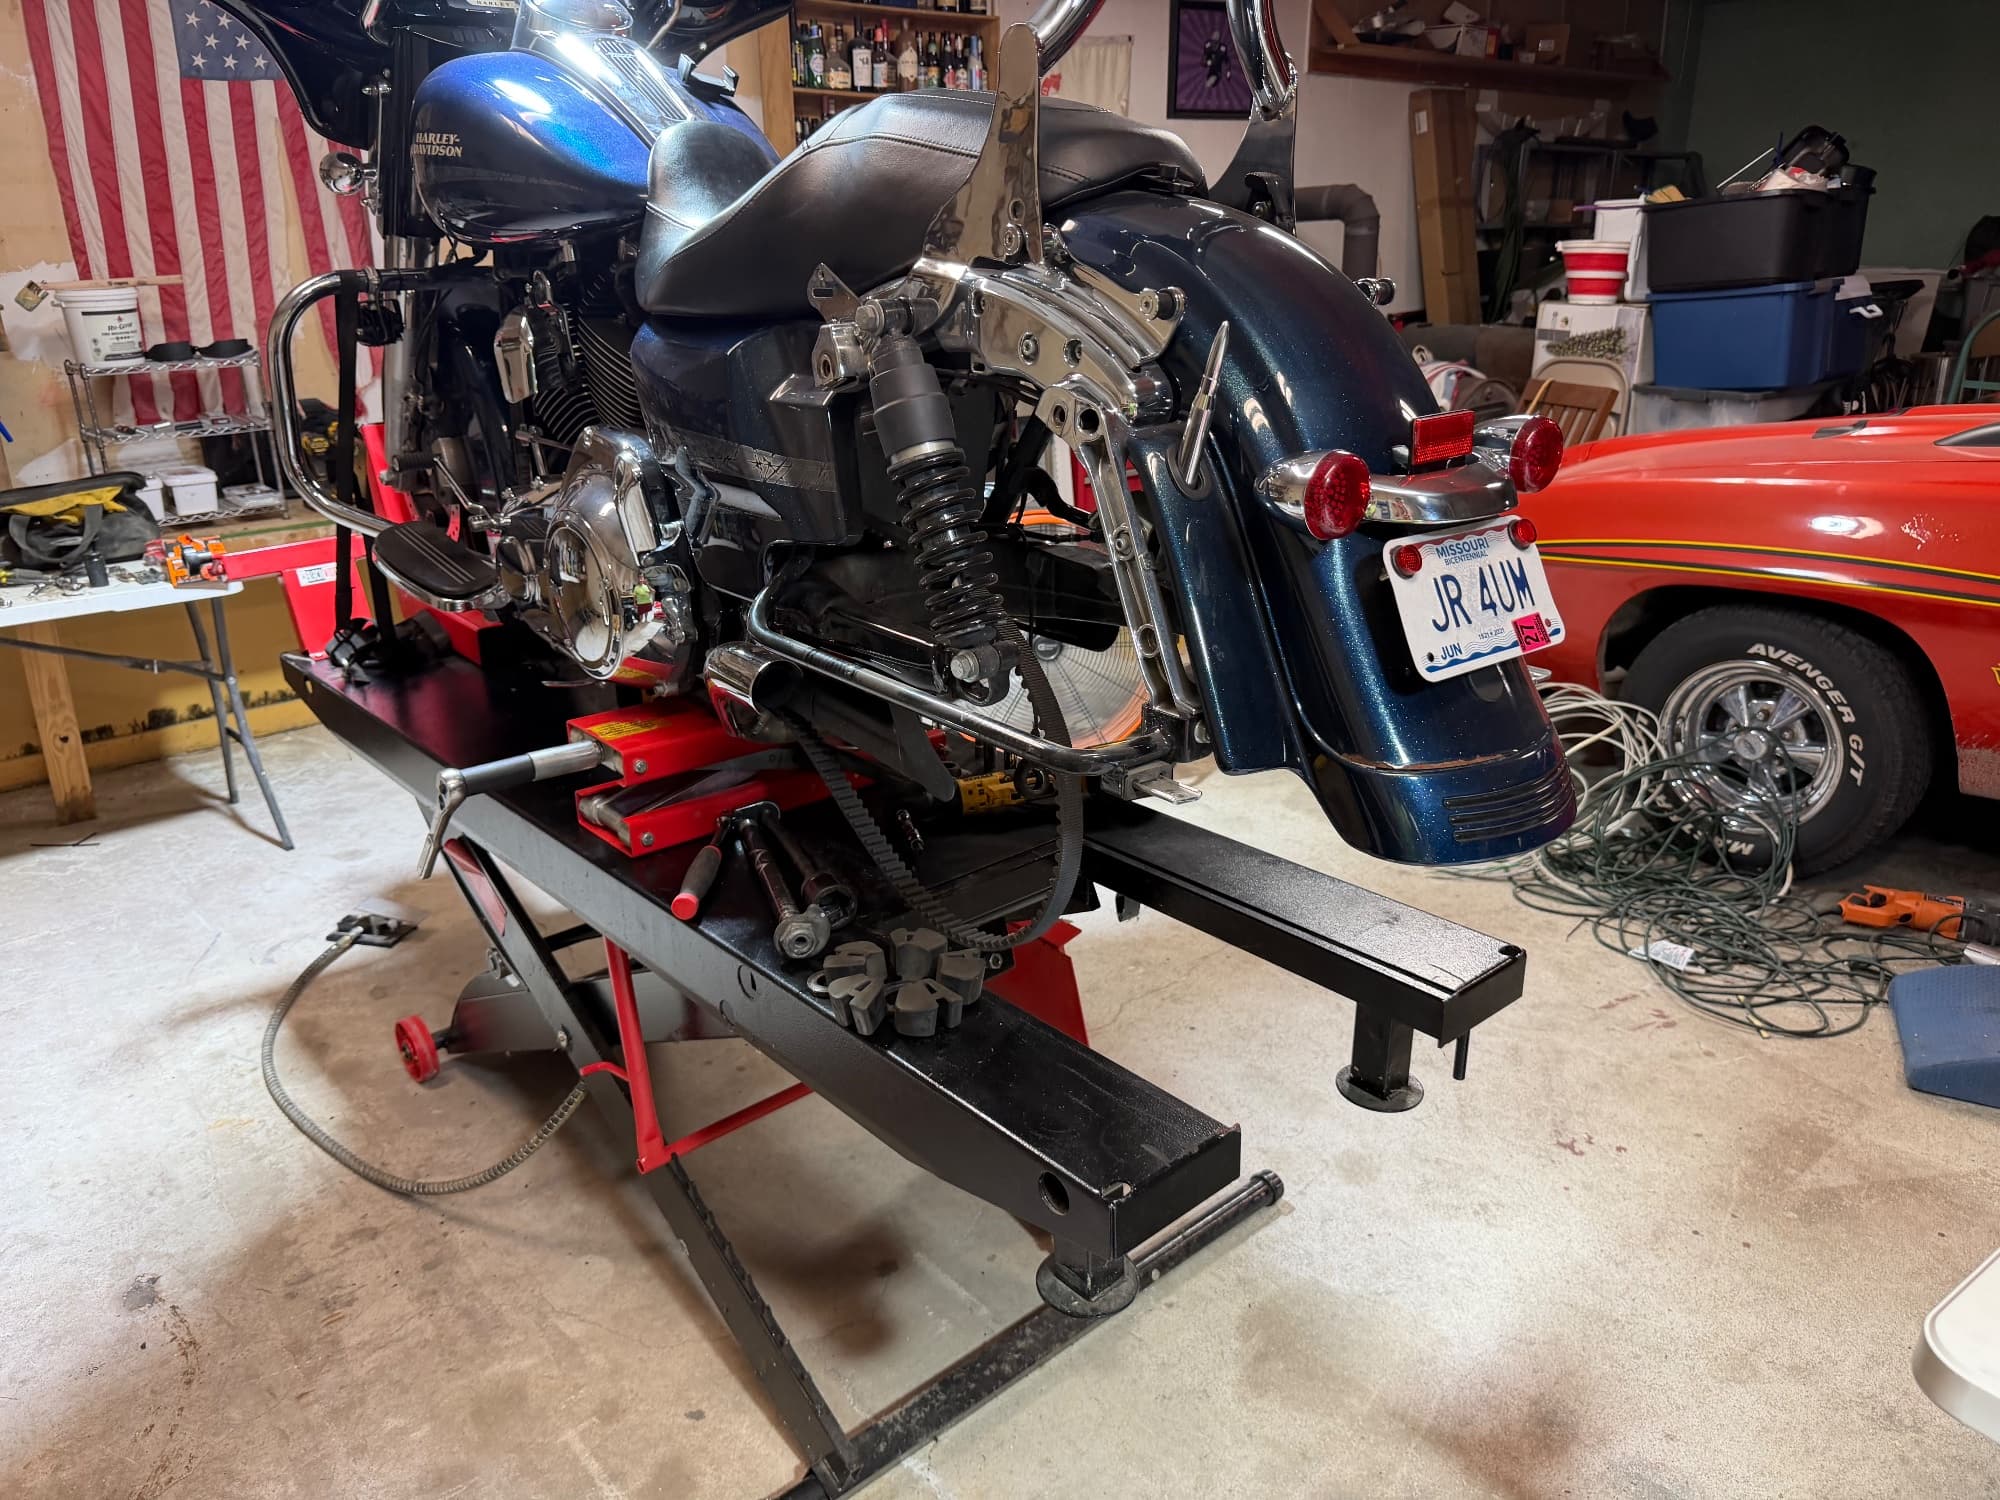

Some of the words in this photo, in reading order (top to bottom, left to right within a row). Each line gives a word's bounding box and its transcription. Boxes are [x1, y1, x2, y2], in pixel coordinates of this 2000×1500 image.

[416, 132, 461, 145] HARLEY-
[411, 144, 463, 158] DAVIDSON
[1435, 536, 1490, 559] MISSOURI
[1444, 550, 1489, 566] BICENTENNIAL
[1432, 574, 1472, 632] JR
[1478, 557, 1536, 617] 4UM
[1519, 624, 1540, 646] 27
[1440, 642, 1463, 660] JUN
[1747, 642, 1856, 724] AVENGER
[1848, 733, 1867, 787] G/T
